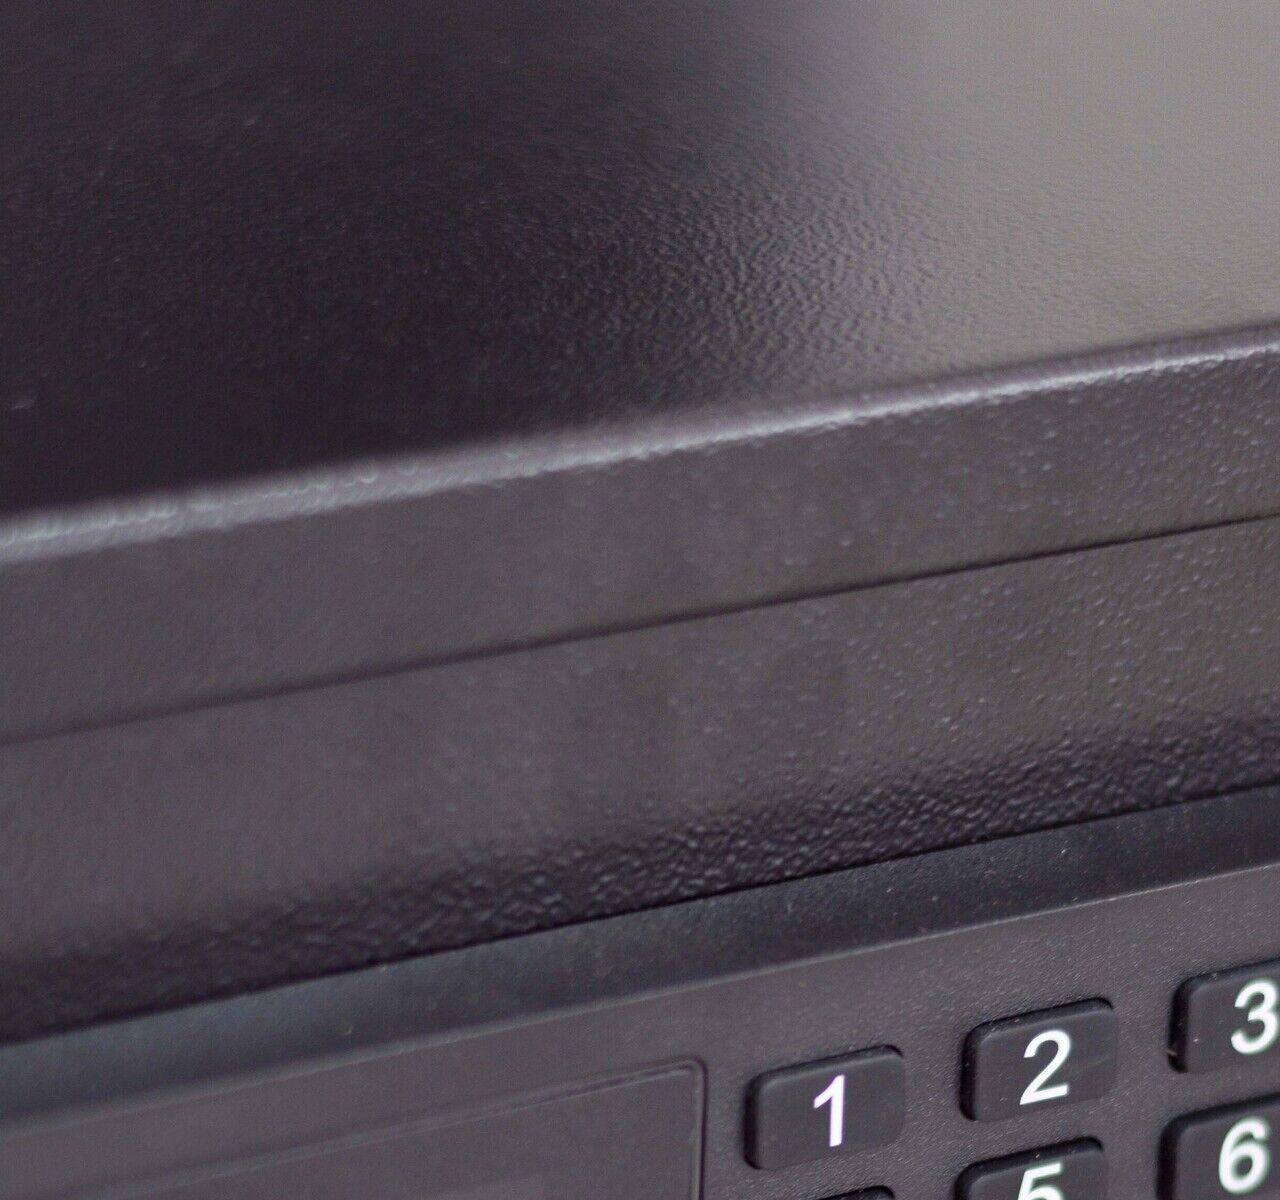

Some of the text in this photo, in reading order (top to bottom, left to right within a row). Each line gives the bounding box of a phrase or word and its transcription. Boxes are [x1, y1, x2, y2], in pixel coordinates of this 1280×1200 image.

[1230, 978, 1280, 1055] 3
[1019, 1029, 1072, 1106] 2
[813, 1073, 846, 1148] 1
[1217, 1116, 1270, 1194] 6
